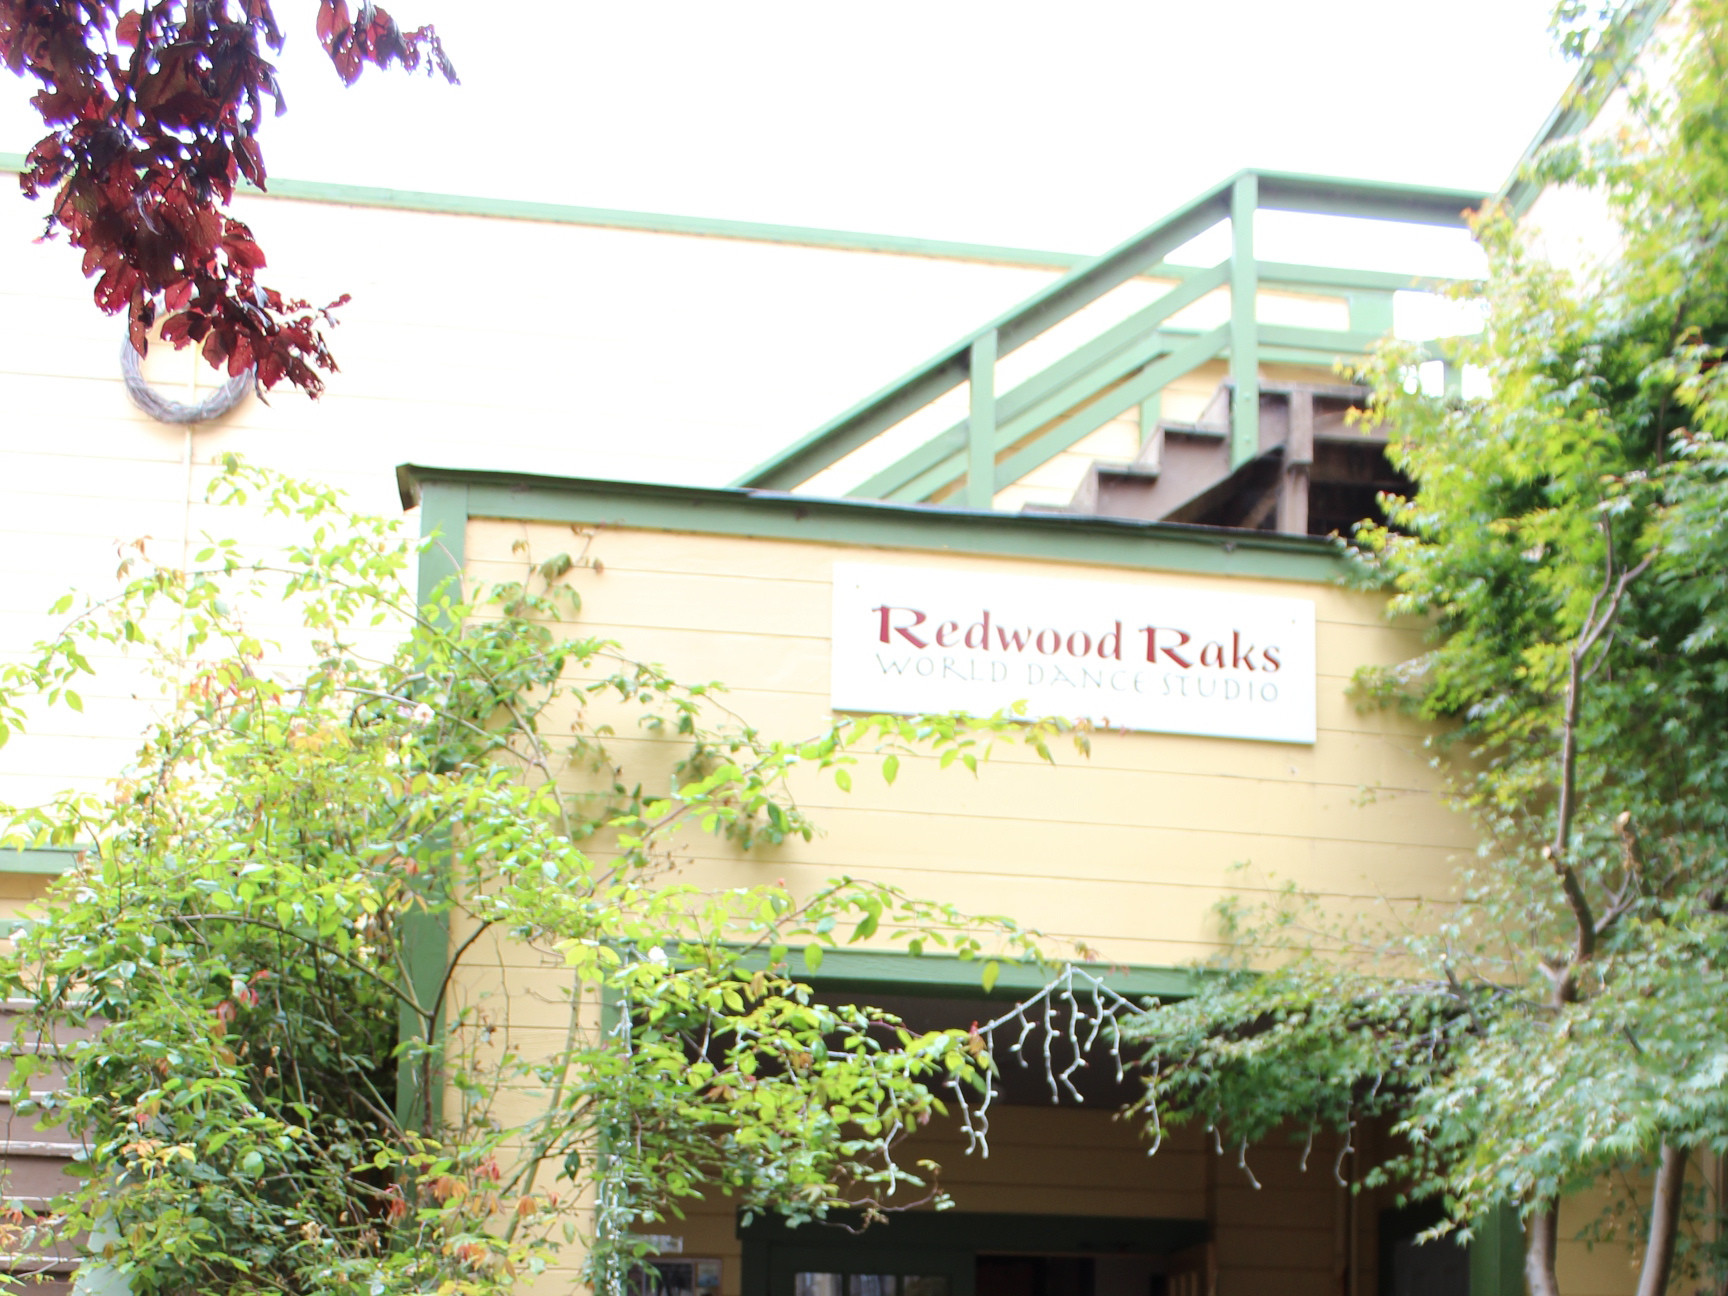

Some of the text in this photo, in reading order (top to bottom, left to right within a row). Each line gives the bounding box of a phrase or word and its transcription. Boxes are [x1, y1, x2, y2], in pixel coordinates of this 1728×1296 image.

[872, 604, 1281, 673] Redwood Raks
[875, 653, 1279, 702] WORLD DANCE STUDIO
